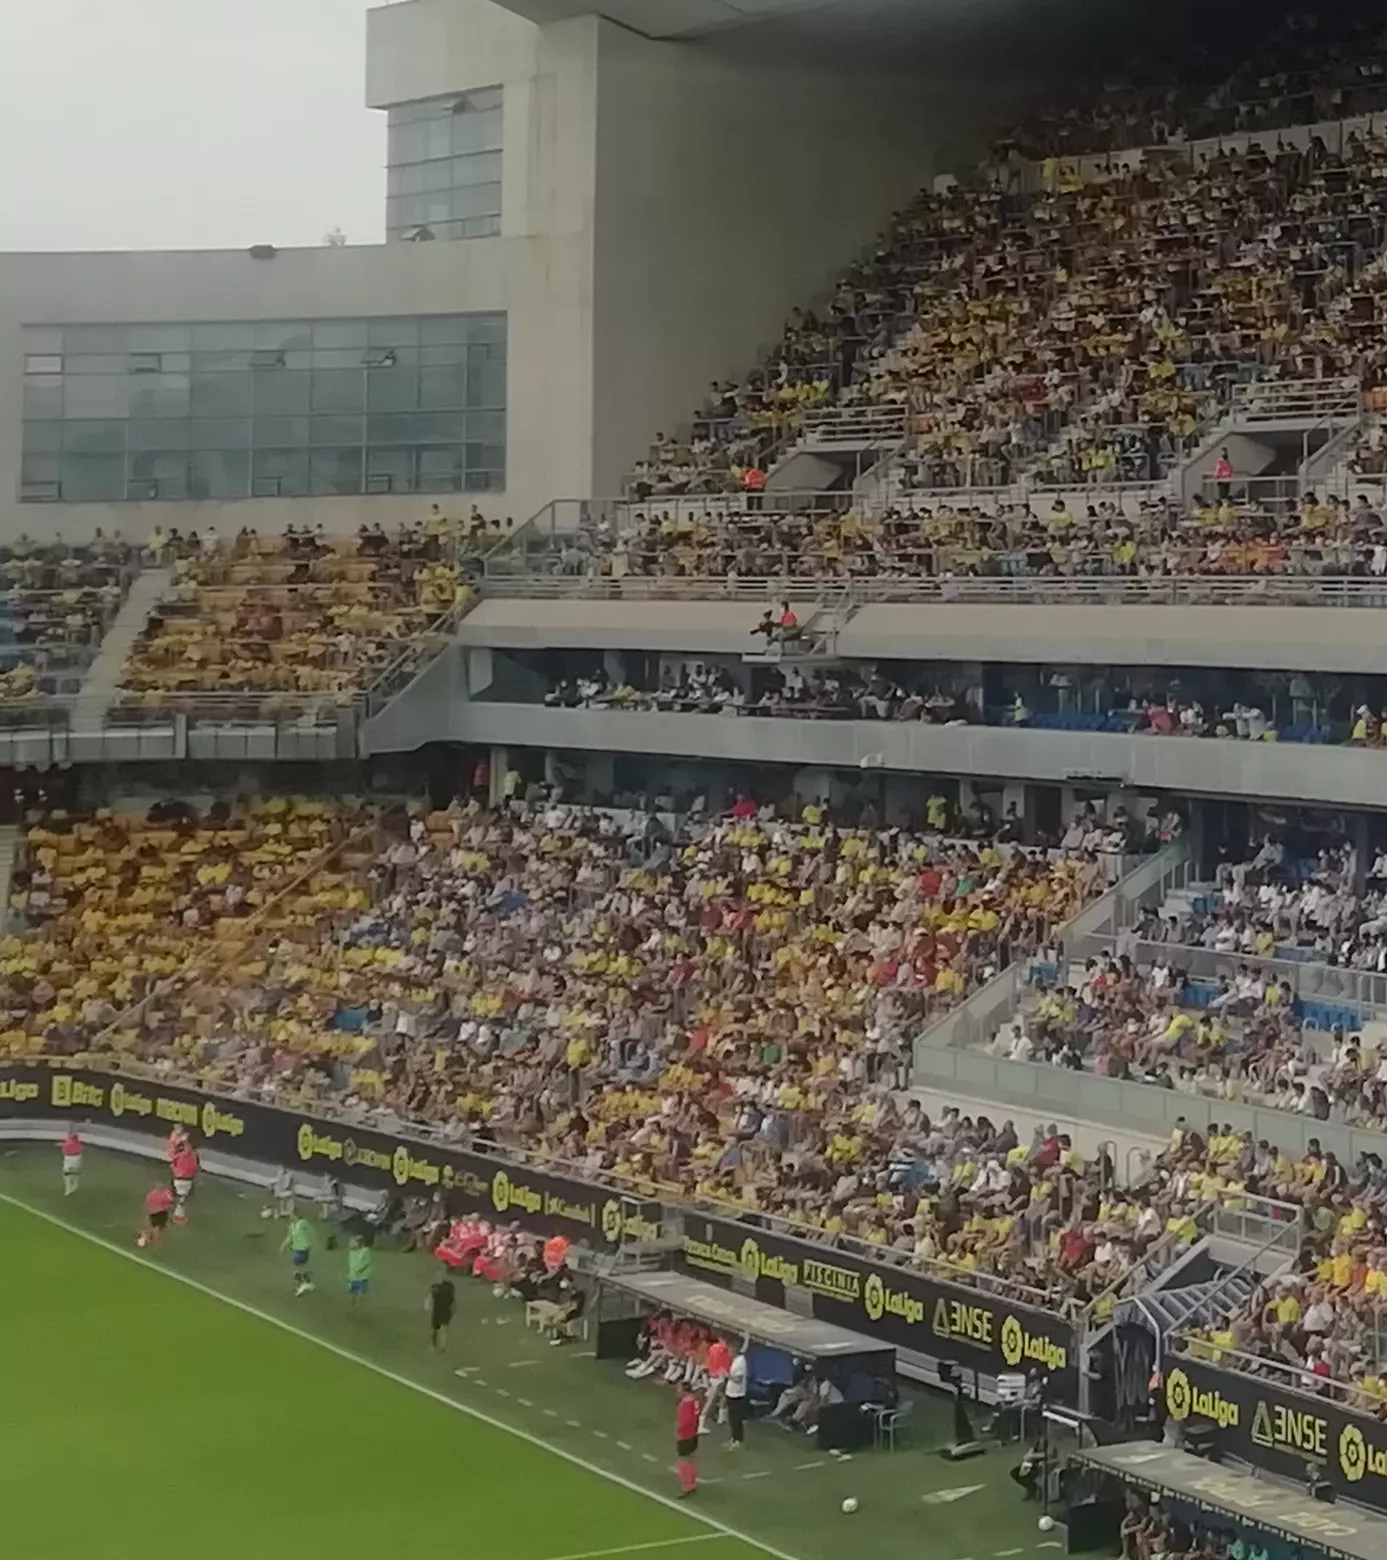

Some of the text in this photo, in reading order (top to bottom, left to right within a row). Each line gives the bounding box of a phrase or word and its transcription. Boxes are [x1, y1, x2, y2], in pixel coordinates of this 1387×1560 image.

[0, 1078, 39, 1101] Liga
[885, 1287, 924, 1324] LaLiga
[1024, 1331, 1067, 1371] LaLiga
[1192, 1386, 1239, 1429] LaLiga
